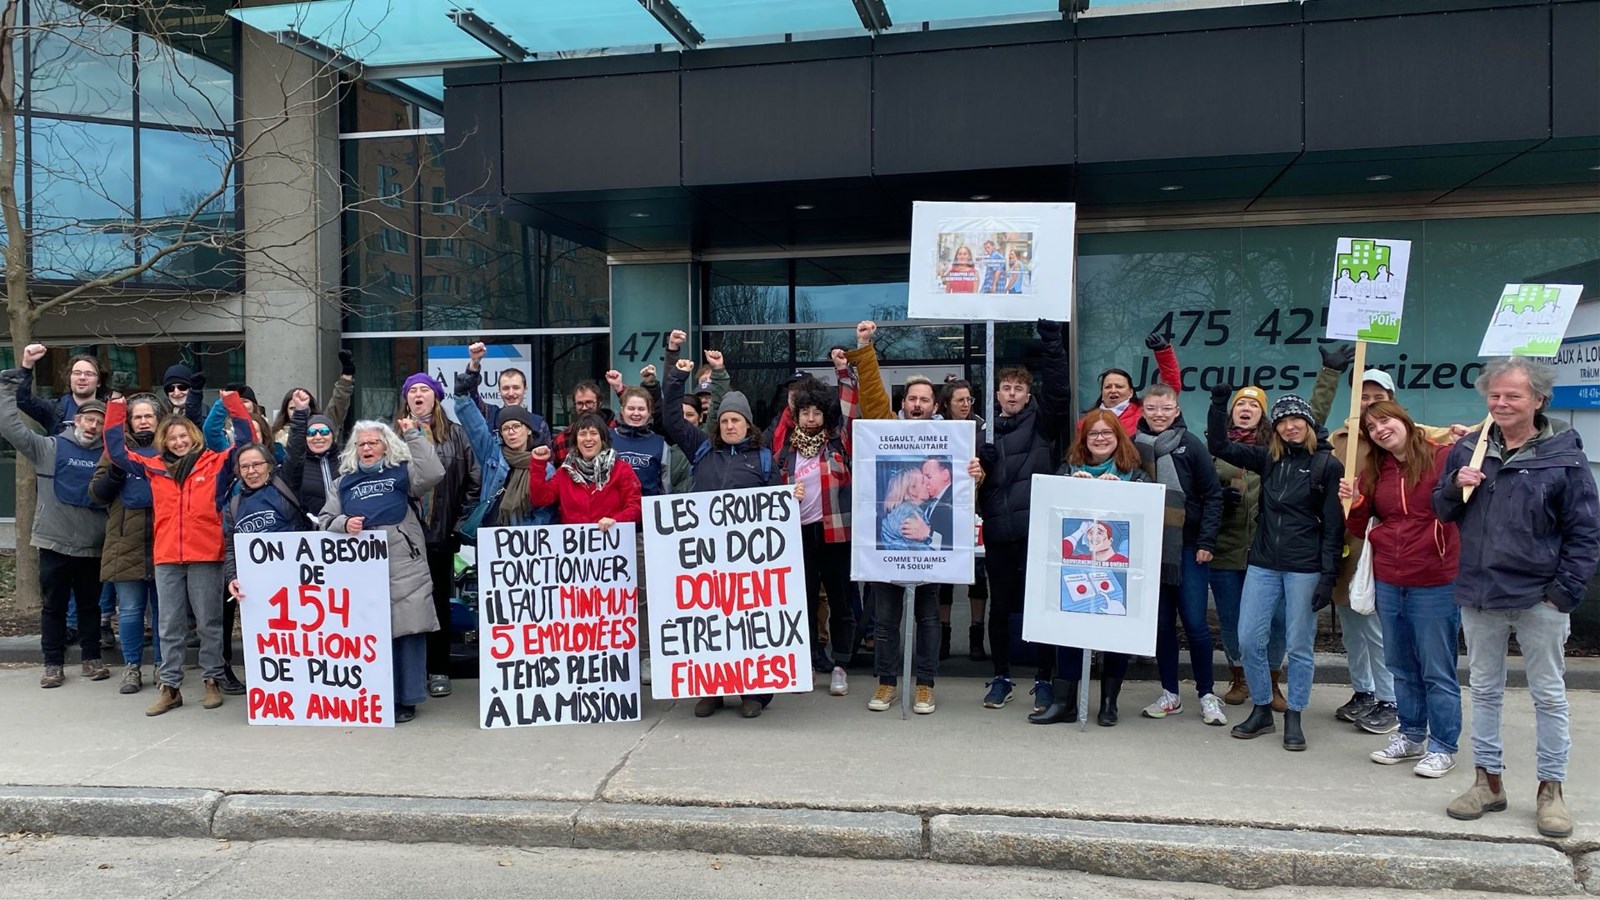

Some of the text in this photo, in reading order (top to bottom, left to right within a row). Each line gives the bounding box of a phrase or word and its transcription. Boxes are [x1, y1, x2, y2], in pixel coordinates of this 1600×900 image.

[654, 490, 792, 535] LES GROUPES
[249, 537, 285, 564] ON
[295, 537, 315, 562] A
[494, 528, 552, 559] POUR
[678, 526, 786, 569] EN DCD
[299, 563, 325, 585] DE
[267, 584, 350, 632] 154
[508, 585, 559, 623] FAUT
[490, 624, 515, 660] 5
[660, 614, 722, 656] ÊTRE
[259, 657, 363, 689] DE PLUS
[496, 656, 560, 691] TEMPS
[248, 687, 383, 724] PAR ANNÉE
[485, 686, 511, 728] À
[516, 693, 551, 725] LA
